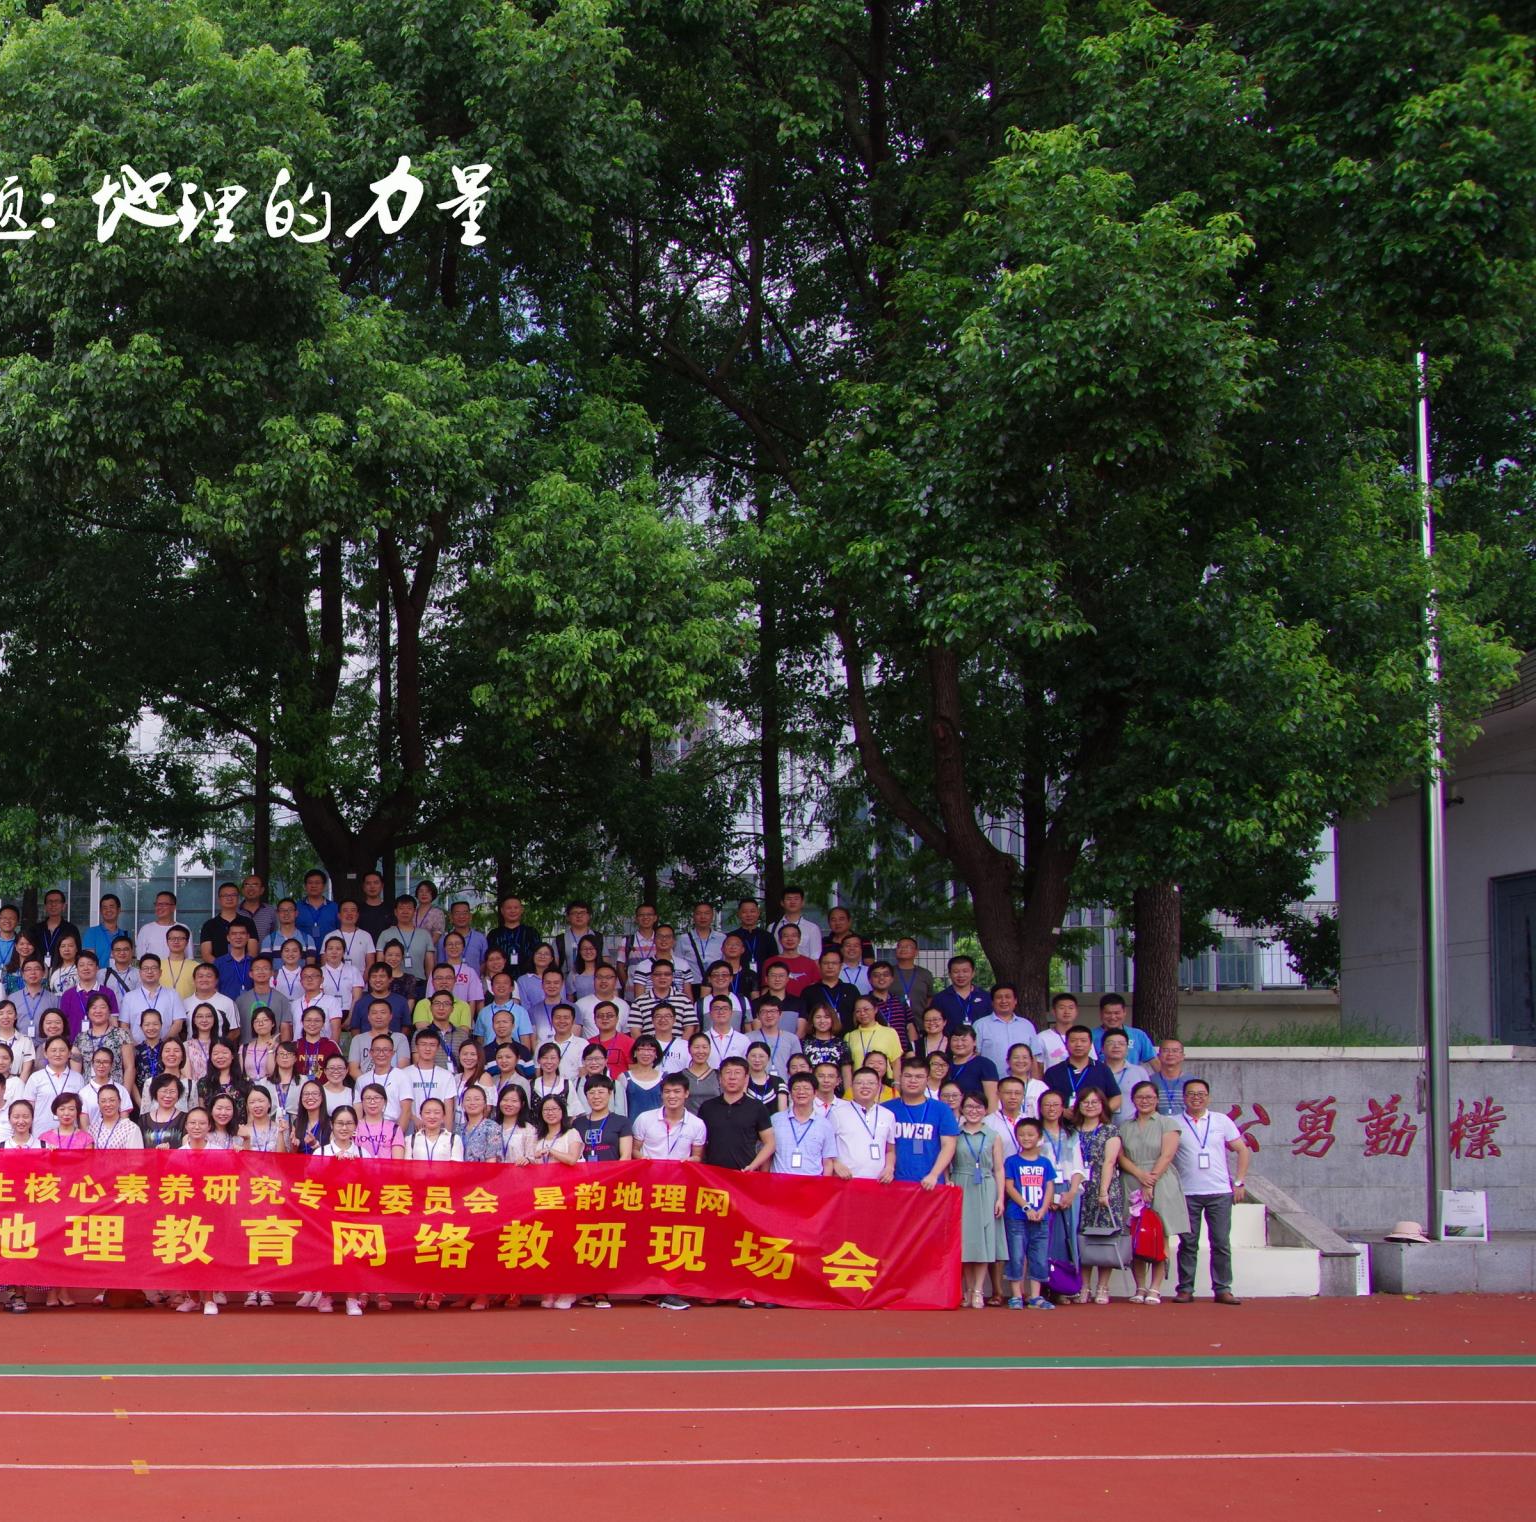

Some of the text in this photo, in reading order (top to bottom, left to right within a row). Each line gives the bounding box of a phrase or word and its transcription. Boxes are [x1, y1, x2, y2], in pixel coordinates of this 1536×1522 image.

[894, 1122, 933, 1140] OWER
[534, 1184, 729, 1217] 星韵地理网
[1021, 1186, 1043, 1207] UP
